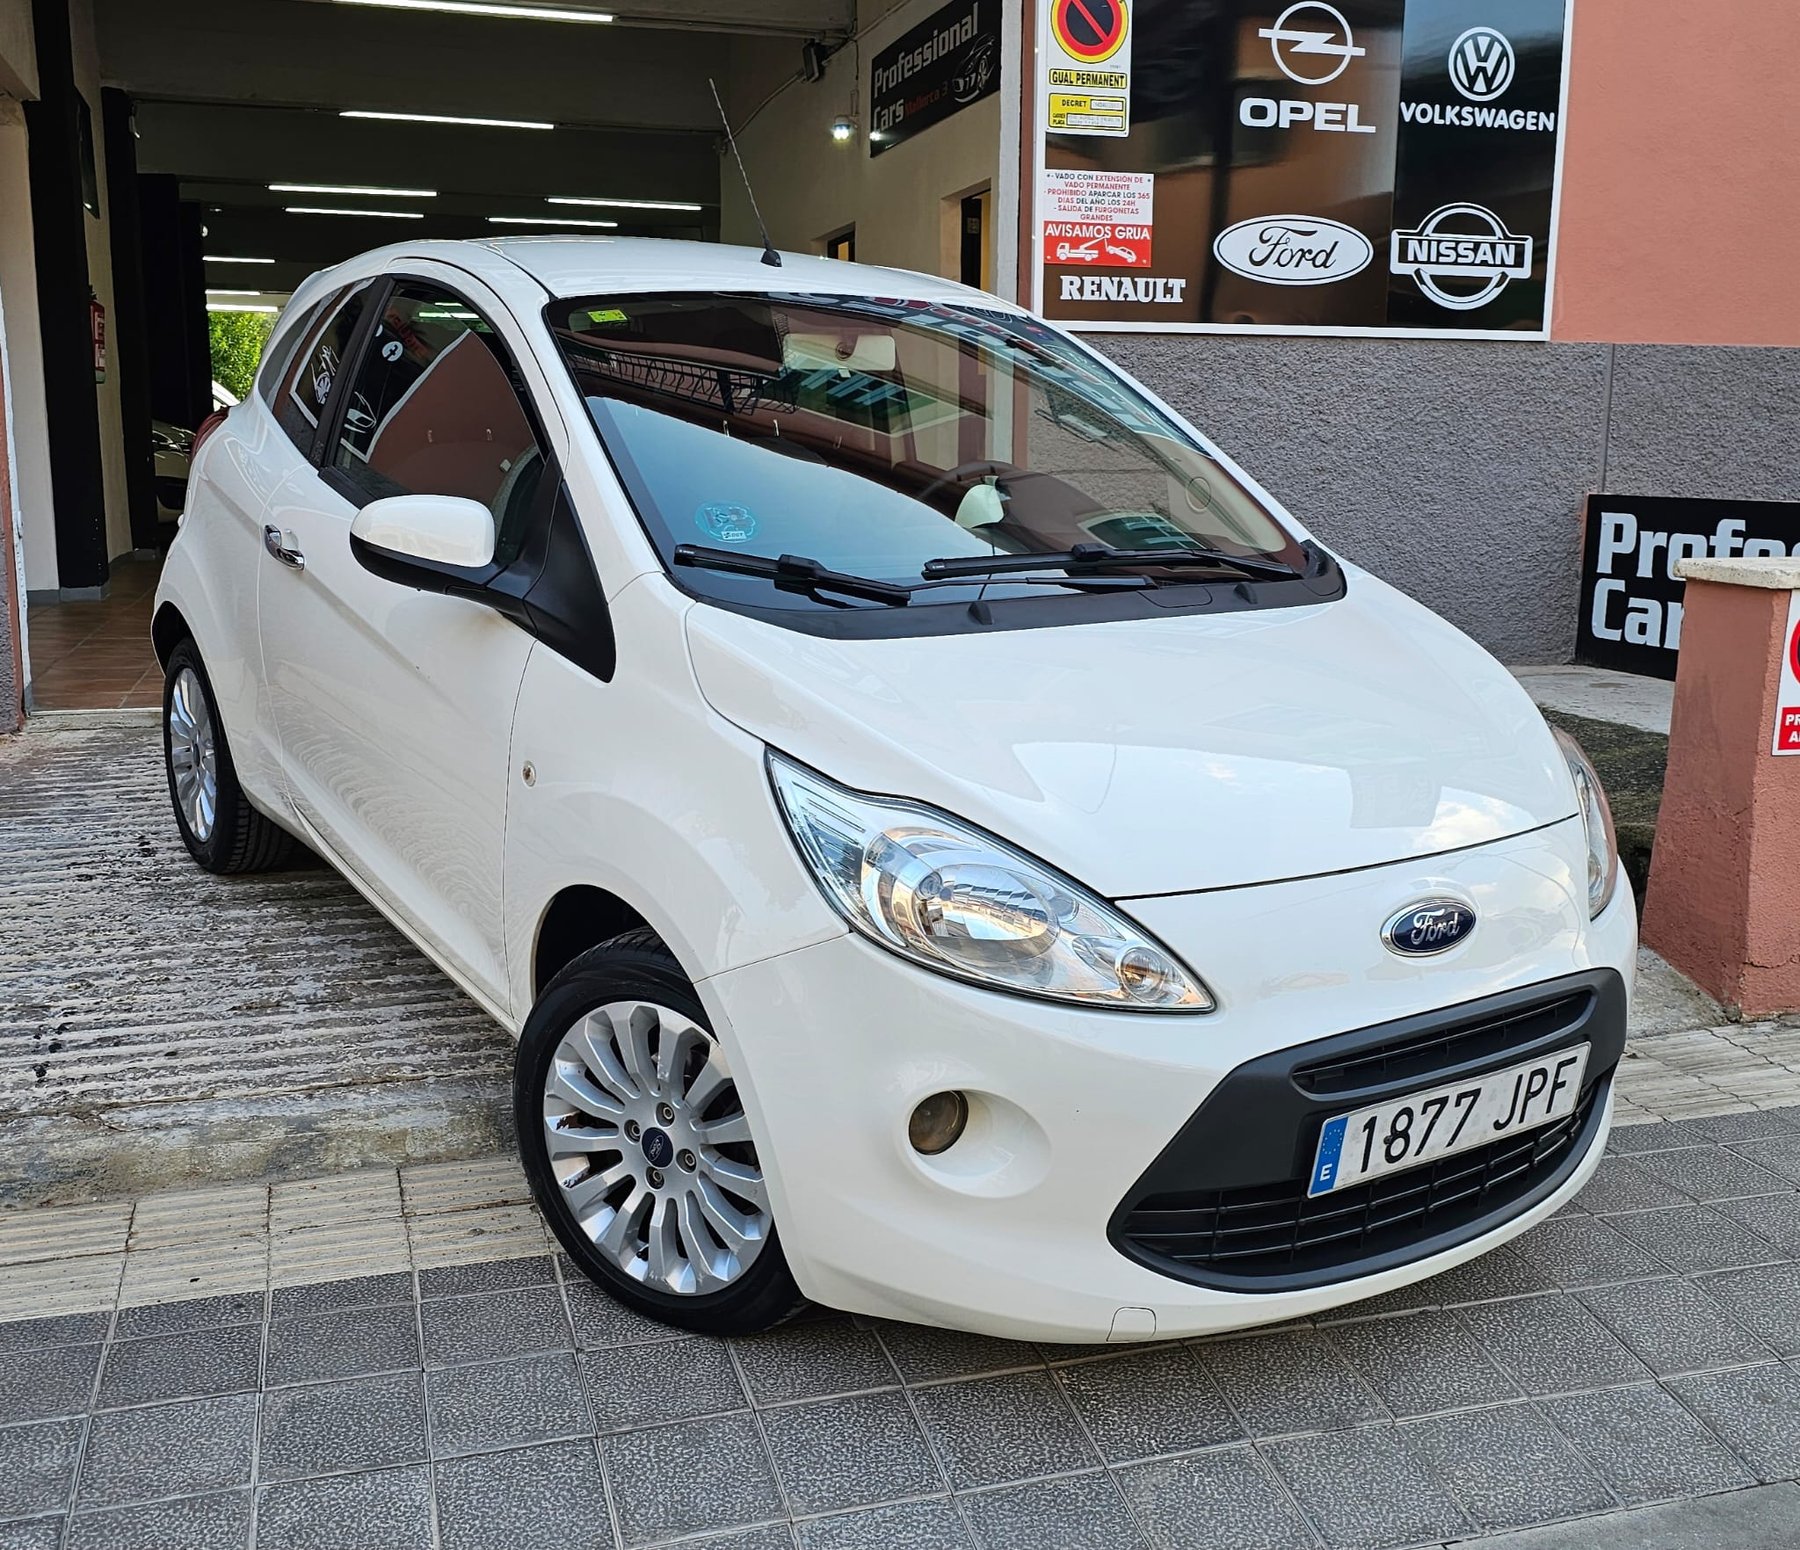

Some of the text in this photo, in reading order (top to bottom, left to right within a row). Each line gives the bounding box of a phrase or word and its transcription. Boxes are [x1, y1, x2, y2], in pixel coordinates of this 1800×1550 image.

[874, 1, 979, 99] Professional
[1052, 71, 1125, 87] GUAL PERMANENT
[1061, 99, 1087, 107] DECRET
[872, 98, 905, 133] Cars
[1239, 97, 1377, 134] OPEL
[1400, 101, 1555, 132] VOLKSWAGEN
[1086, 182, 1131, 190] PERMANENTE
[1134, 176, 1143, 184] DE
[1047, 188, 1087, 197] PROHIBIDO
[1088, 190, 1122, 198] APARCAR
[1089, 197, 1106, 205] AÑO
[1080, 213, 1113, 221] GRANDES
[1094, 206, 1140, 215] FURGONETAS
[1045, 223, 1151, 240] AVISAMOS GRUA
[1248, 226, 1339, 269] Ford
[1407, 239, 1516, 266] NISSAN
[1060, 275, 1186, 303] RENAULT
[1596, 511, 1800, 582] Prof
[1788, 730, 1800, 743] A
[1410, 908, 1460, 946] Ford
[1360, 1056, 1578, 1174] 1877 JPF
[1319, 1163, 1333, 1182] E
